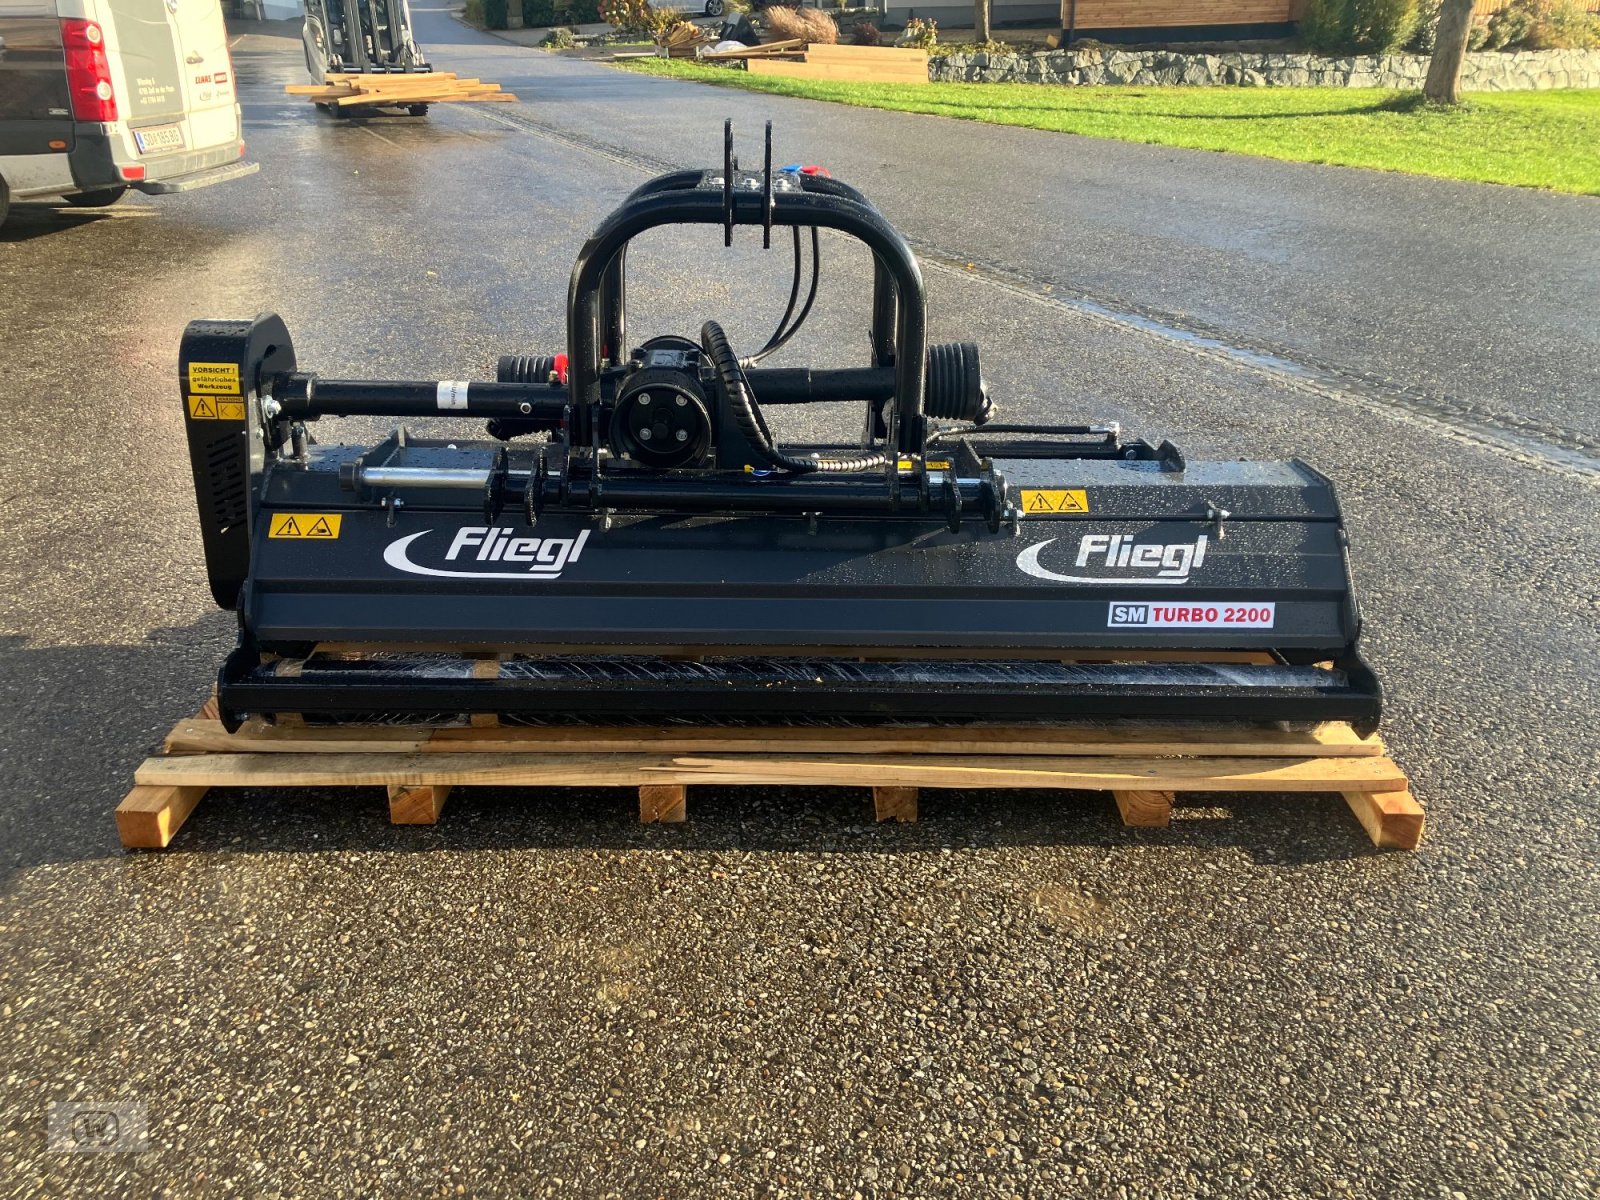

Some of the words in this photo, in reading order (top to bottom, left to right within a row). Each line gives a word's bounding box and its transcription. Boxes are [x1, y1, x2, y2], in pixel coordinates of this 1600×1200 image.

[195, 75, 211, 84] CLAAS
[192, 366, 231, 374] VORSICHT
[444, 526, 591, 571] Fliegl
[1075, 534, 1208, 577] Fliegl
[1113, 606, 1146, 623] SM
[1152, 607, 1219, 622] TURBO
[1223, 607, 1271, 622] 2200
